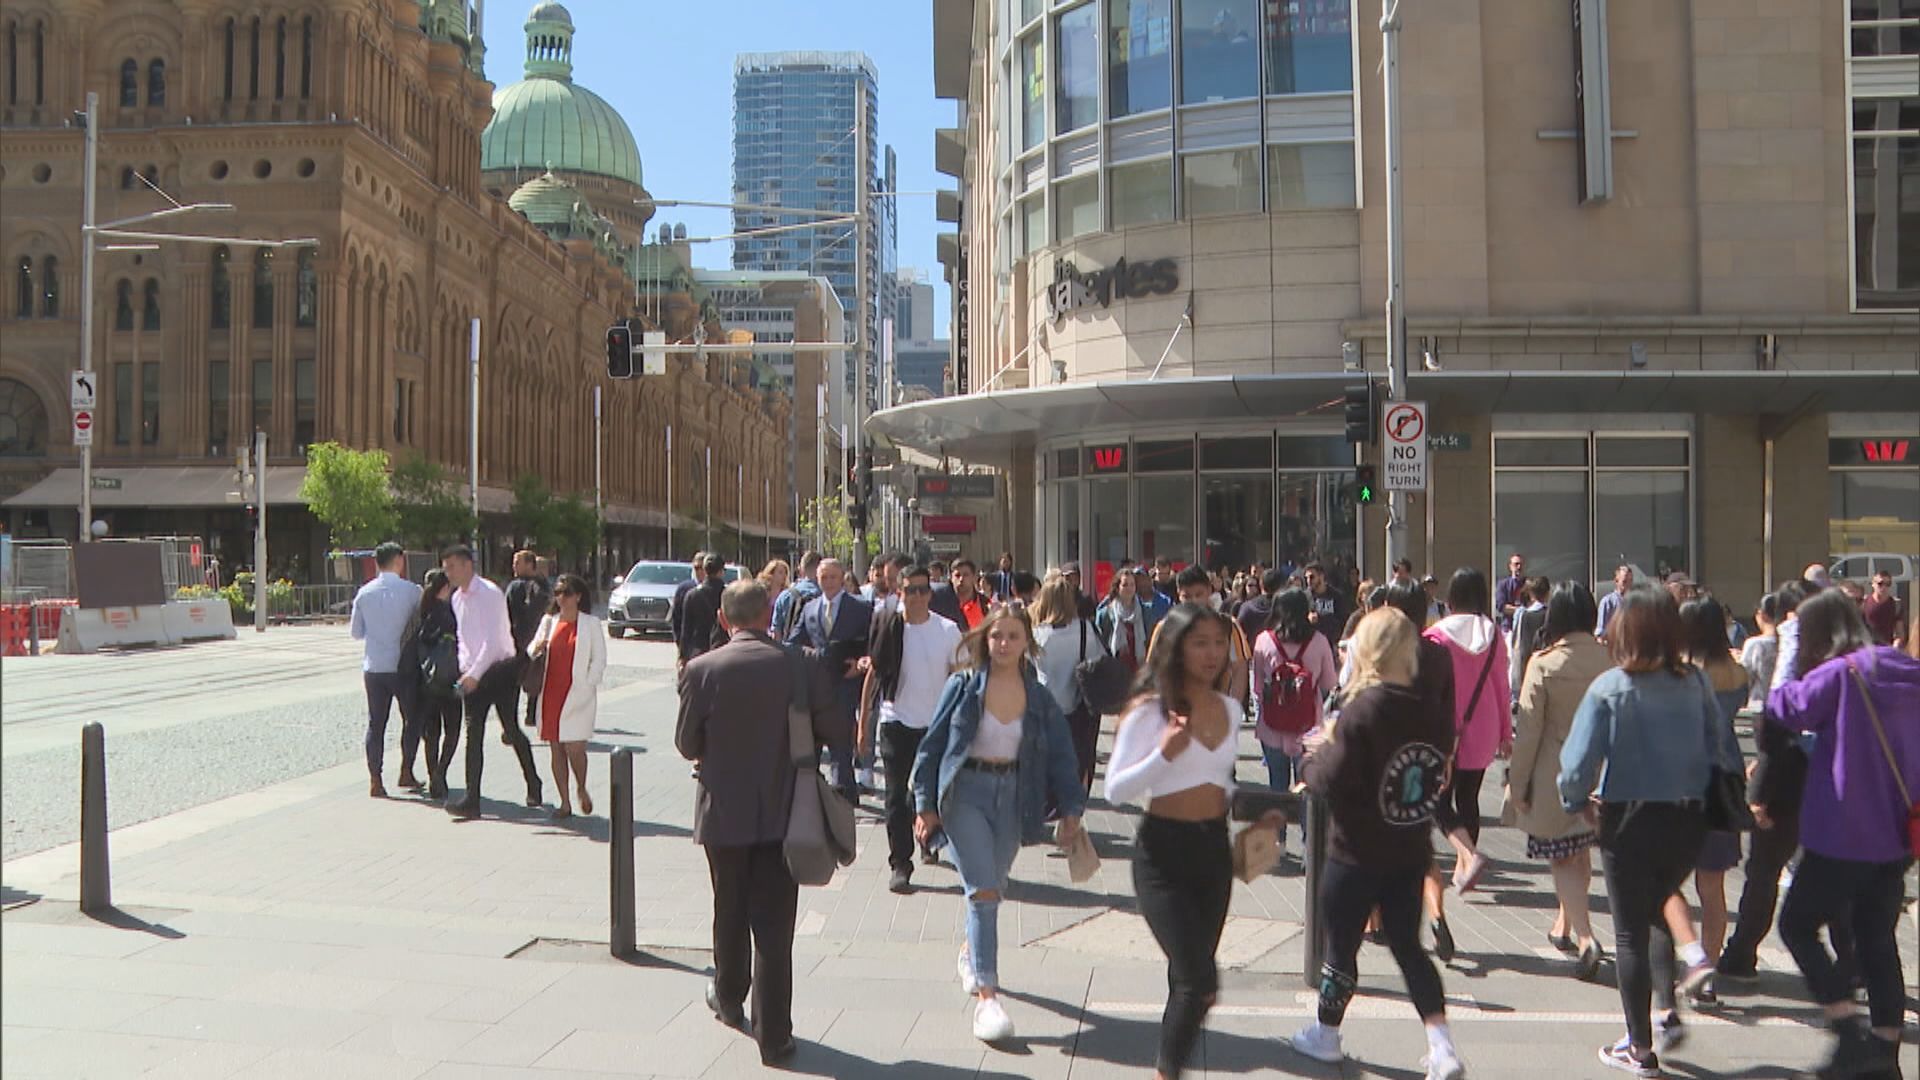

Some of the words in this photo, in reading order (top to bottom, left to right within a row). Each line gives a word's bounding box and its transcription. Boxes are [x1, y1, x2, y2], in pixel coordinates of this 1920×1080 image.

[1428, 434, 1447, 446] Park
[1449, 434, 1458, 445] St
[1393, 446, 1417, 460] NO
[1388, 463, 1421, 474] RIGHT
[1389, 476, 1421, 486] TURN
